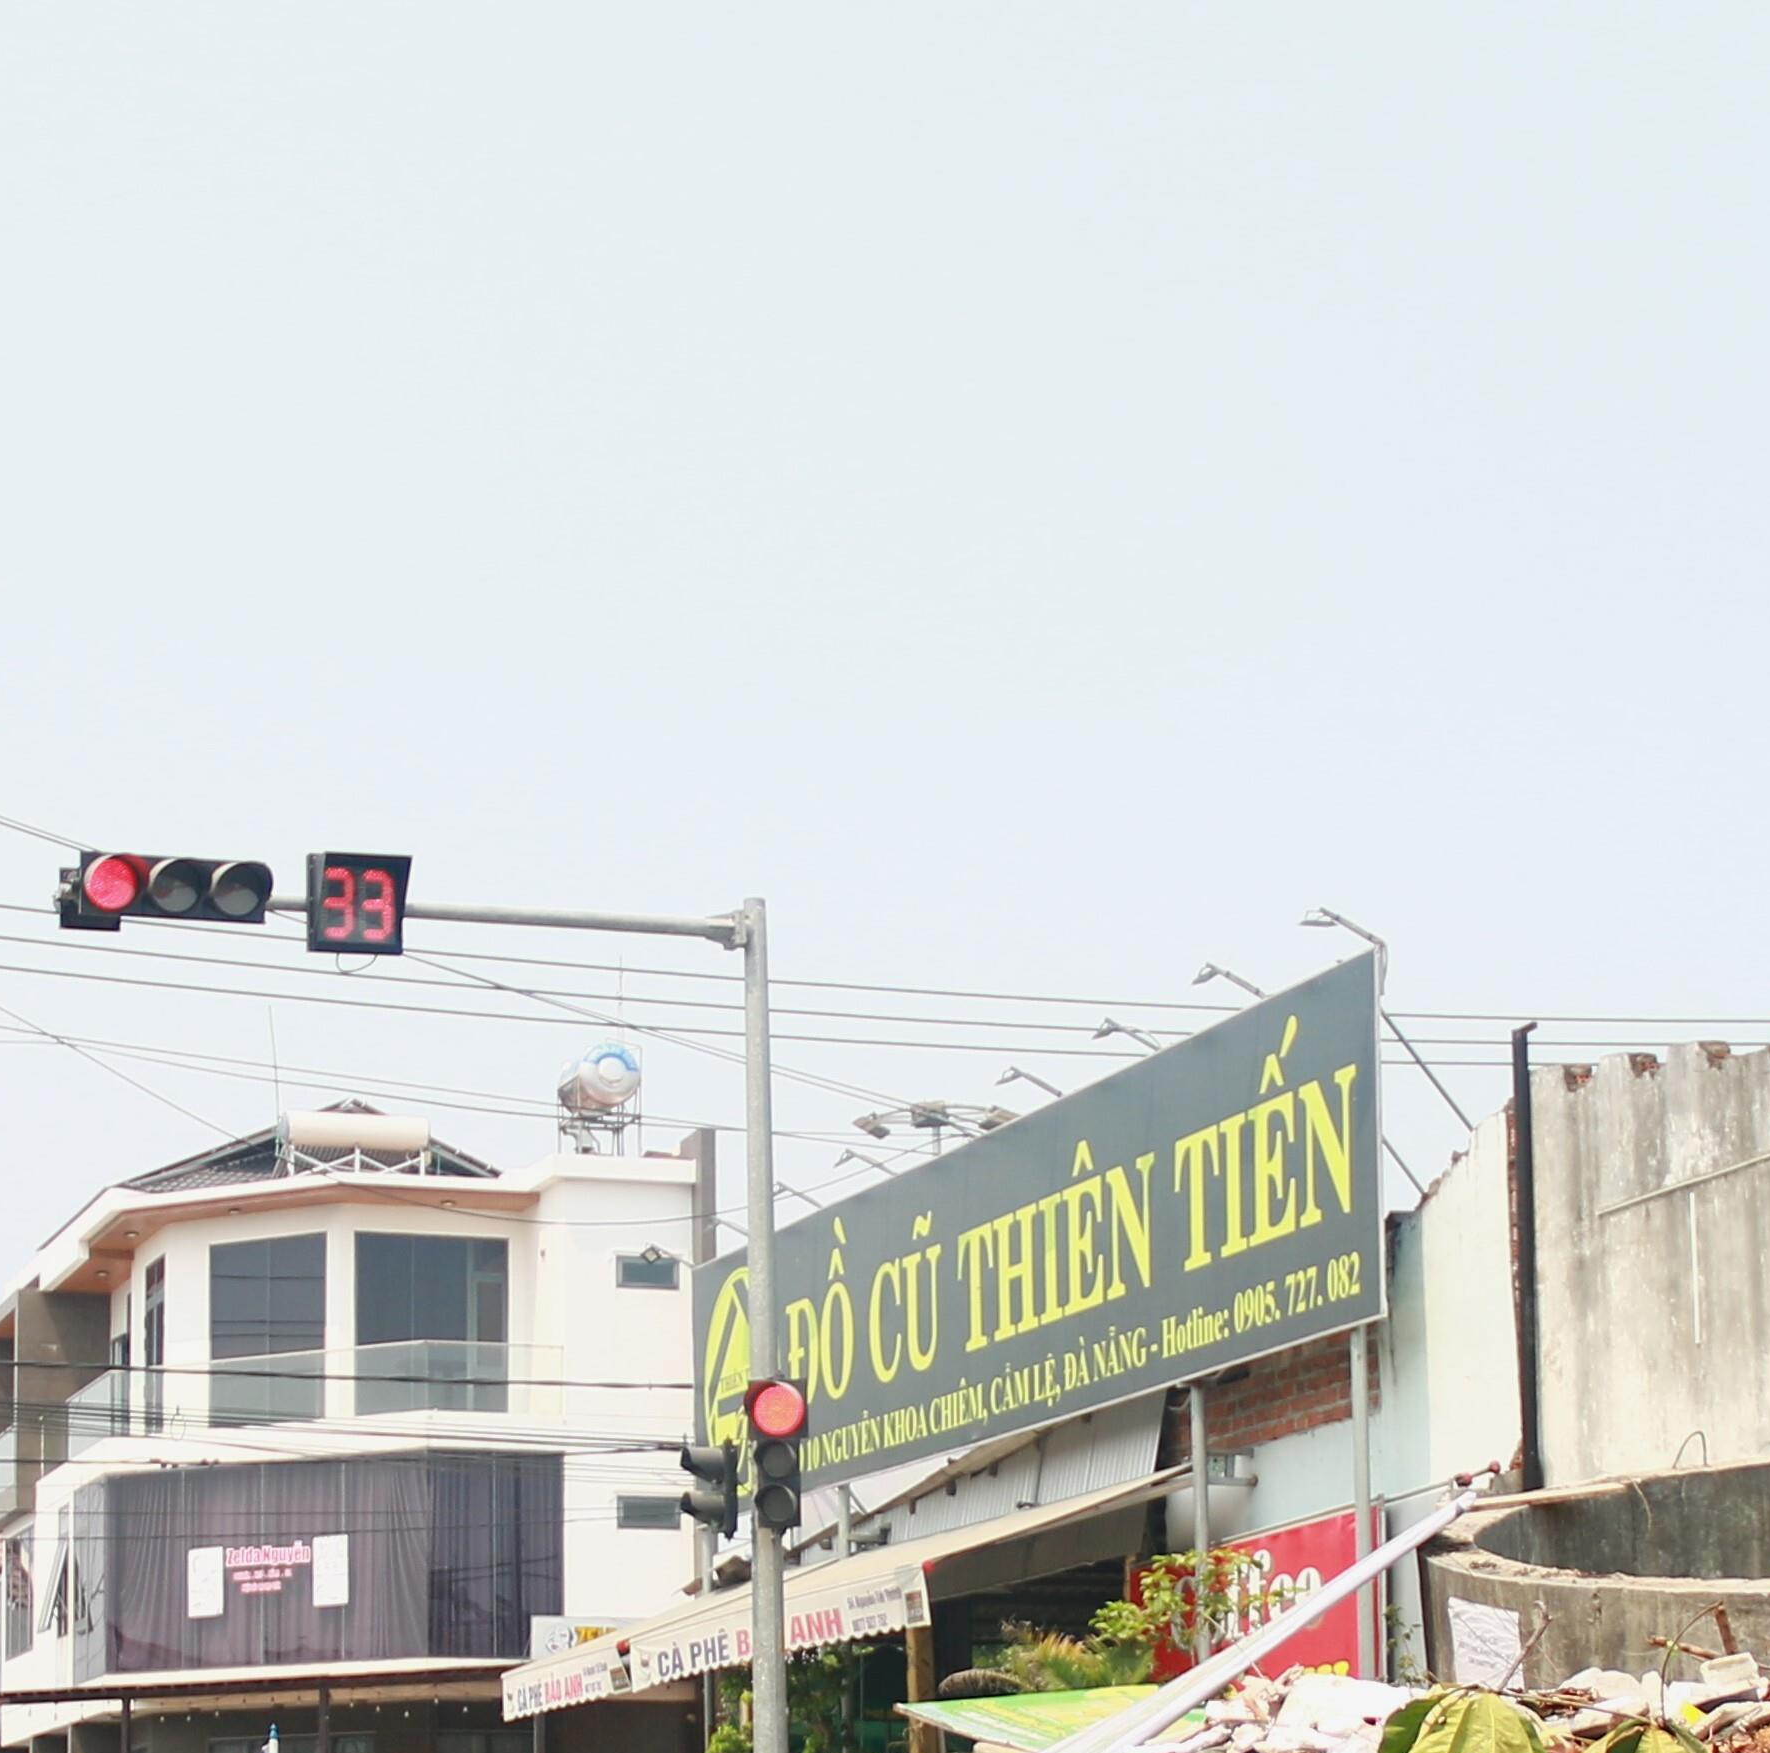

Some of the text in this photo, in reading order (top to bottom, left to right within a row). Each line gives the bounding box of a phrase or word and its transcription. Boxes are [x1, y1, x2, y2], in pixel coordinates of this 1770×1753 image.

[323, 866, 395, 941] 33
[785, 1015, 1357, 1403] ĐỒ CŨ THIÊN TIẾN
[882, 1403, 928, 1448] KHOA
[929, 1377, 988, 1434] CHIÊM,
[1063, 1336, 1090, 1391] ĐÀ
[1161, 1306, 1229, 1359] Hotline:
[1234, 1281, 1281, 1333] 0905.
[1284, 1265, 1323, 1318] 727.
[1326, 1251, 1362, 1302] 082
[657, 1642, 684, 1678] CÀ
[689, 1628, 730, 1670] PHÊ
[790, 1607, 845, 1644] ANH
